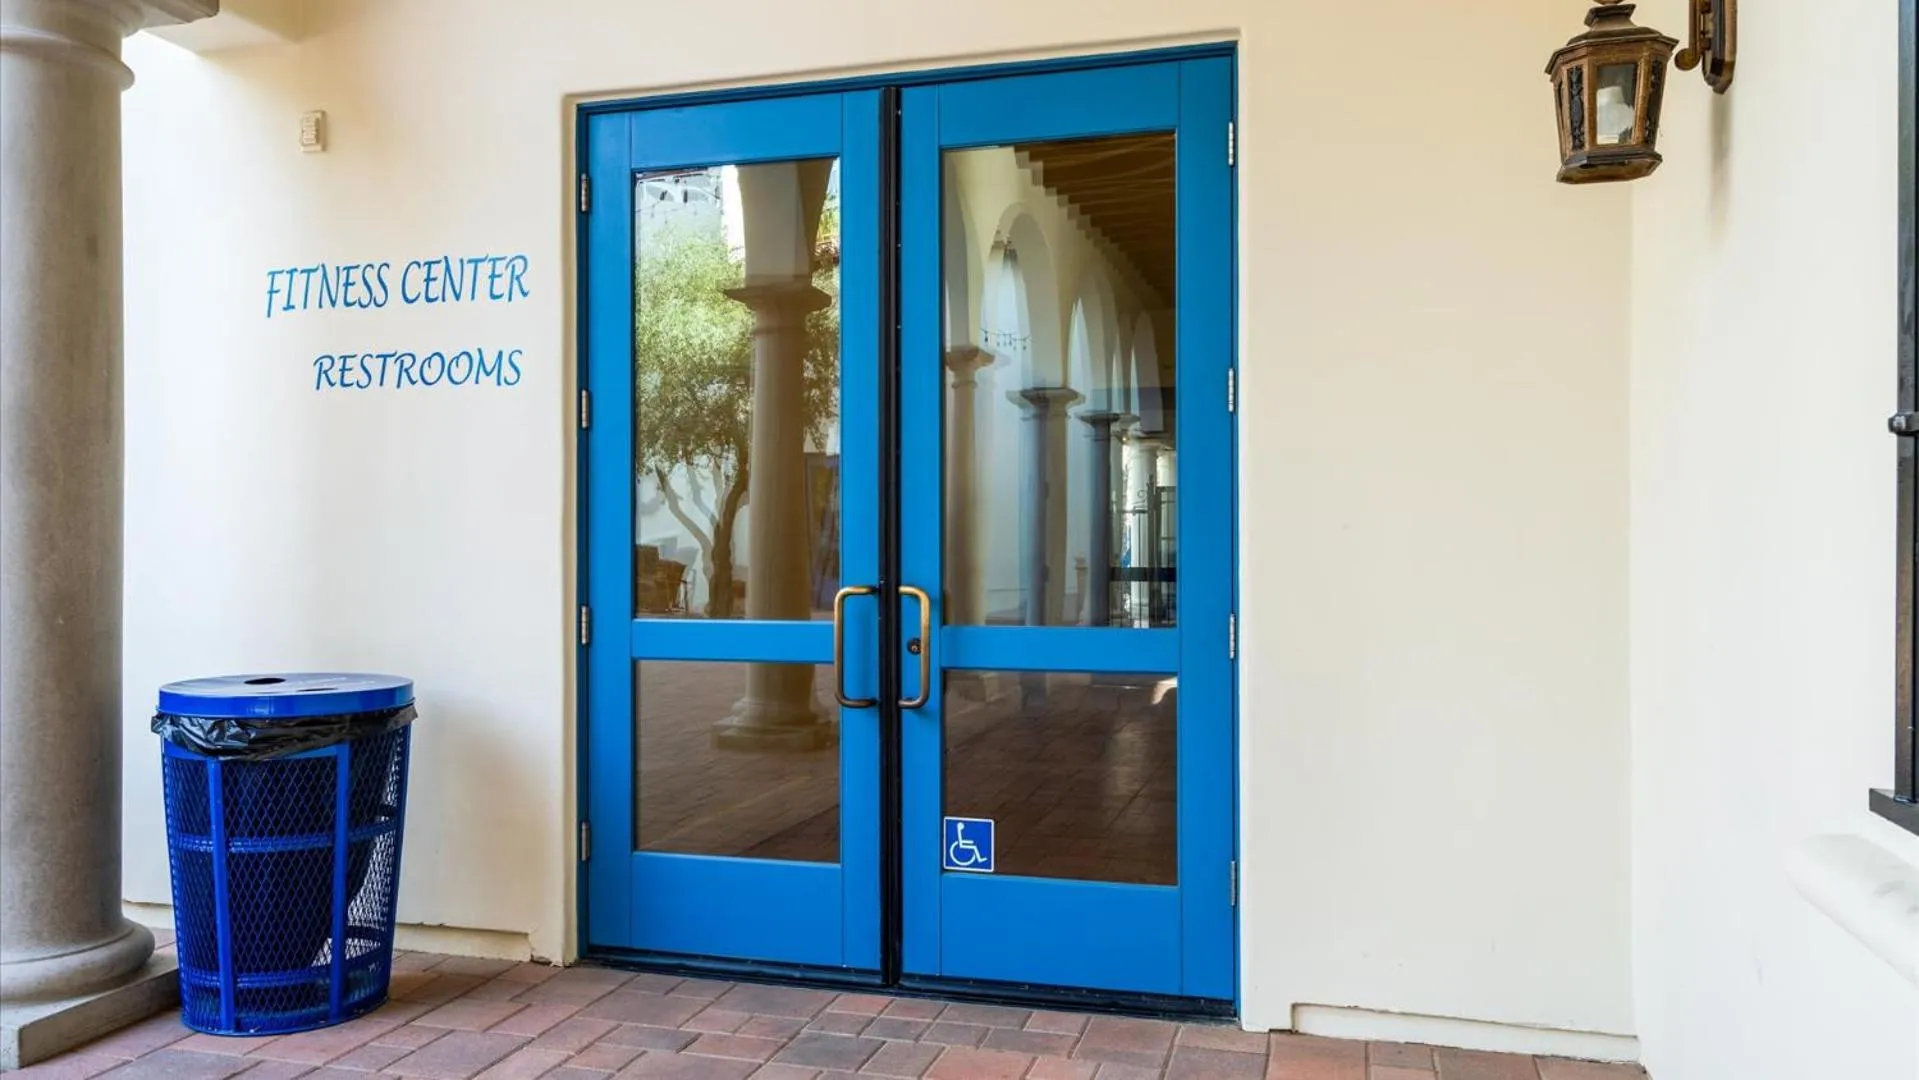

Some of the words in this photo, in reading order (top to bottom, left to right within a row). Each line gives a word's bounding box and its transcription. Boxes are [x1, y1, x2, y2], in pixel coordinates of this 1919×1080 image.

[266, 262, 391, 318] FITNESS
[400, 254, 530, 303] CENTER
[313, 347, 523, 390] RESTROOMS
